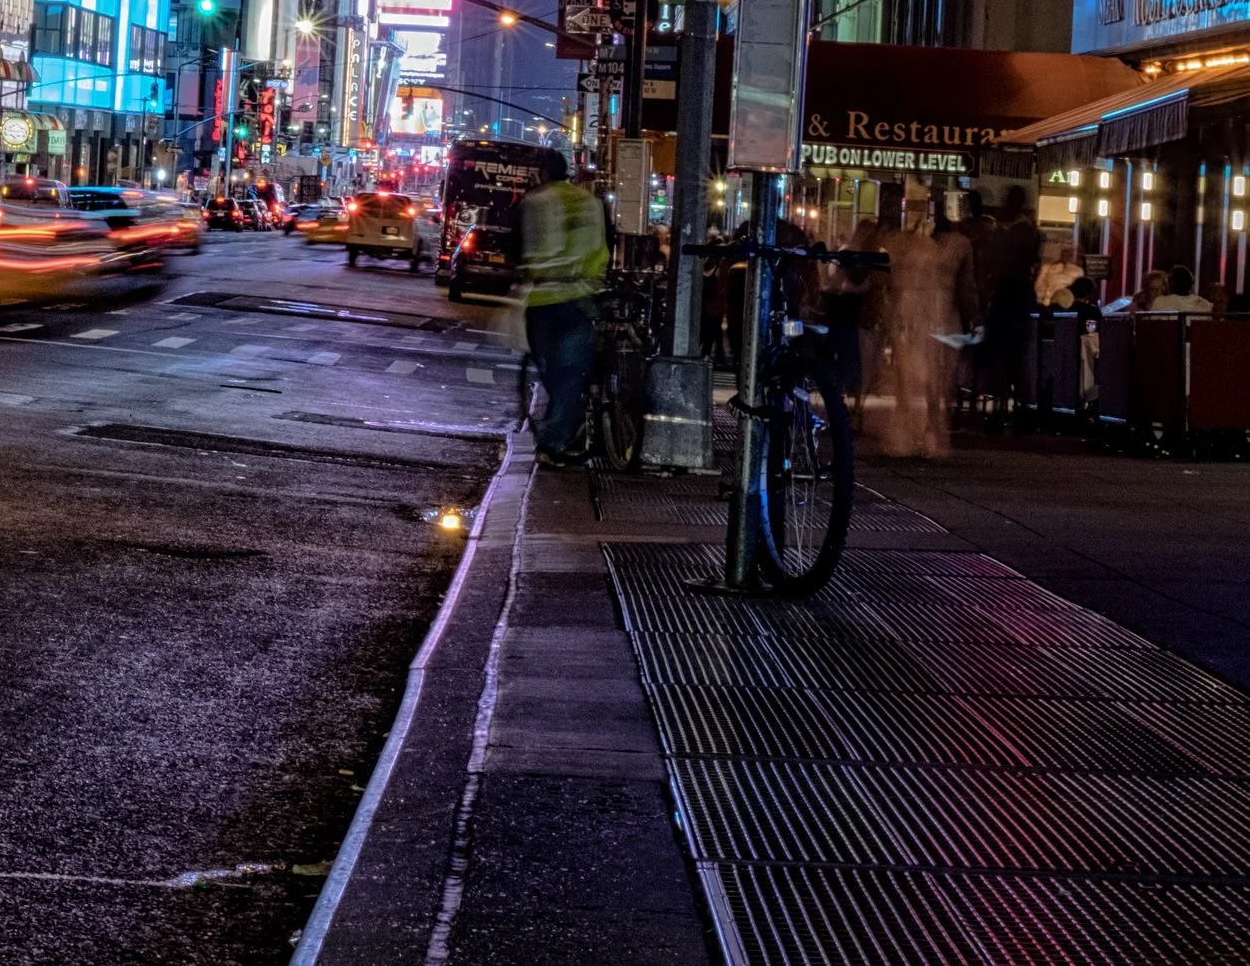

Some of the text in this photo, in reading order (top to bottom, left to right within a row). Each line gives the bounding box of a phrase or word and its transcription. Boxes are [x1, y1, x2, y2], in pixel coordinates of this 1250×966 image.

[582, 14, 607, 27] ONE
[598, 61, 625, 75] M104
[586, 79, 599, 87] ON
[808, 113, 831, 138] &
[801, 144, 967, 172] PUB ON LOWER LEVEL
[463, 160, 541, 185] PREMIER
